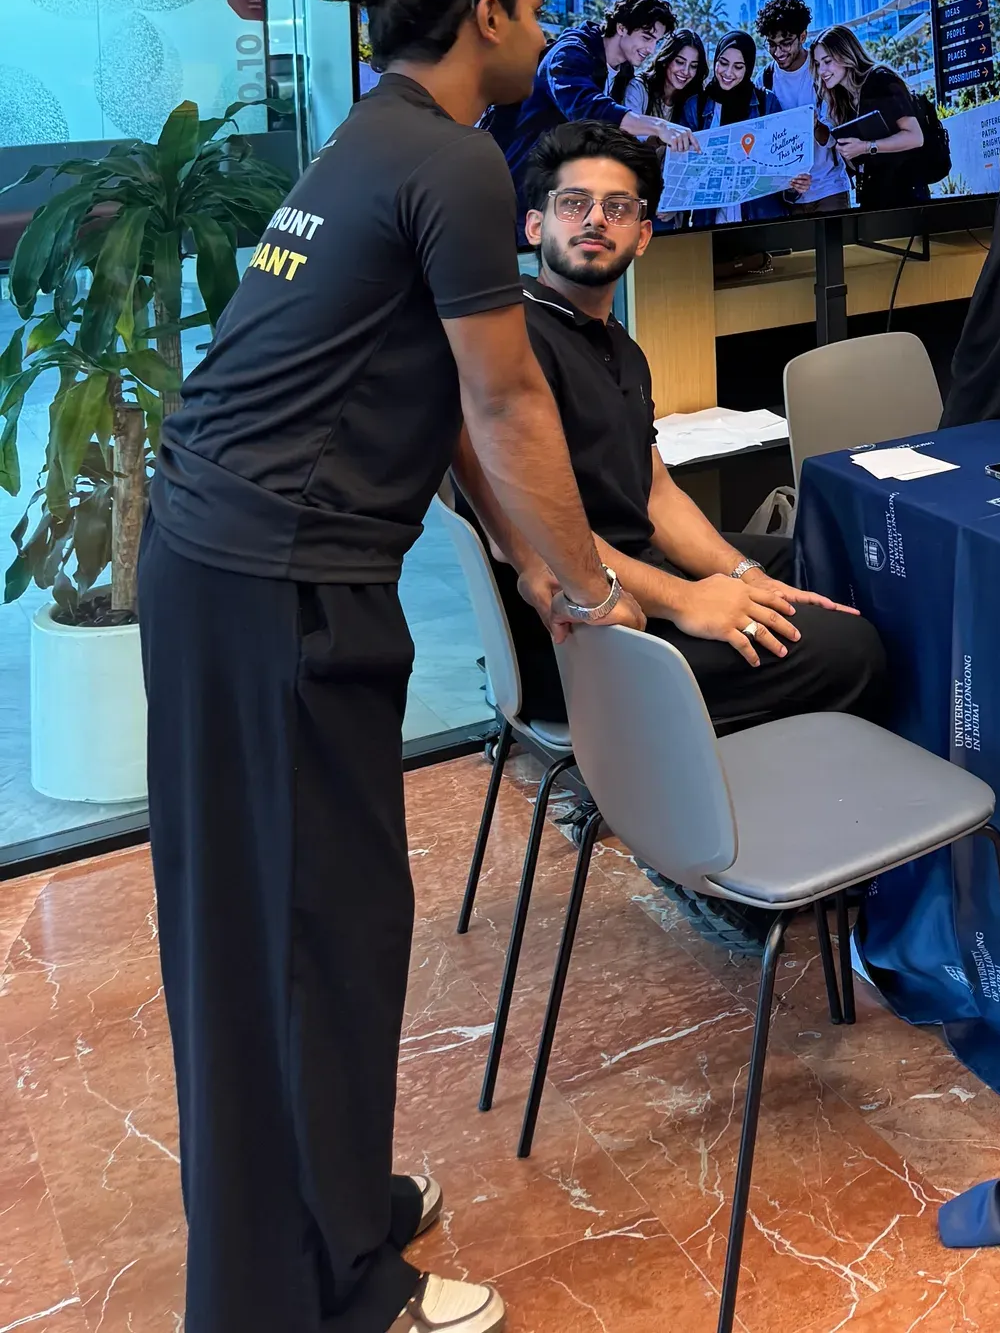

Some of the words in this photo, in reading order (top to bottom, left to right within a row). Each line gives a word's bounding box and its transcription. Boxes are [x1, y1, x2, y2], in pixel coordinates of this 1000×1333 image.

[945, 6, 961, 18] IDEAS
[946, 26, 966, 40] PEOPLE
[947, 49, 967, 62] PLACES
[949, 69, 981, 85] POSSIBILITIES
[772, 128, 787, 143] Next
[981, 127, 998, 138] PATHS
[770, 134, 800, 155] Challenge
[777, 151, 790, 162] This
[791, 140, 805, 153] Way
[890, 491, 900, 566] WOLLONGONG
[886, 511, 896, 574] UNIVERSITY
[896, 533, 905, 568] DUBAI
[896, 566, 902, 578] OF
[964, 654, 972, 735] WOLLONGONG
[955, 679, 964, 747] UNIVERSITY
[972, 703, 980, 737] DUBAI
[964, 735, 973, 749] OF
[973, 738, 981, 752] IN
